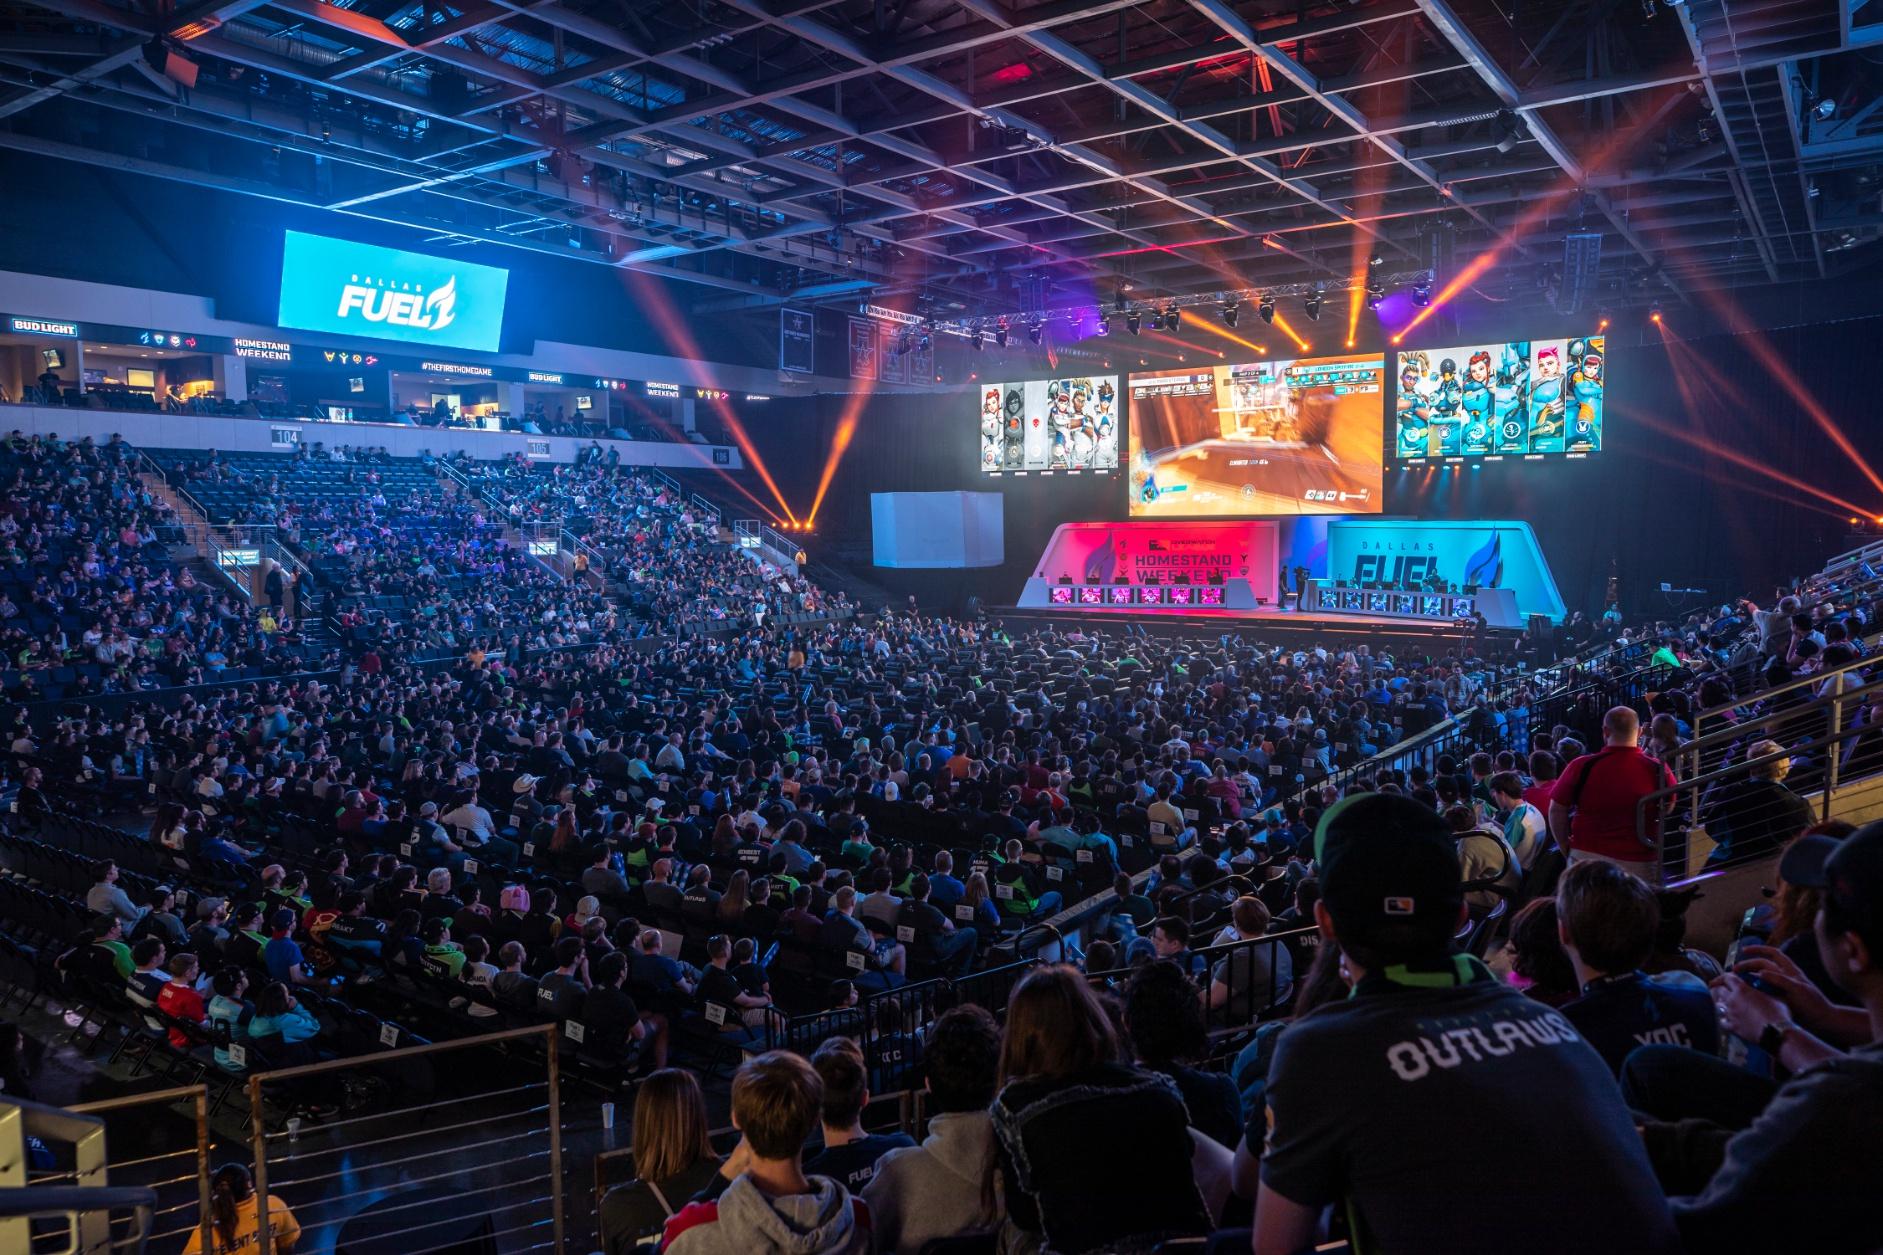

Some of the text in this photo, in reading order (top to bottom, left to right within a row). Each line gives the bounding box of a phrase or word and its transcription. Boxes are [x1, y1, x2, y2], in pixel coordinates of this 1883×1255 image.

[351, 274, 422, 292] DALLAS
[337, 285, 432, 328] FUEL
[14, 320, 75, 335] BUD LIGHT
[235, 338, 290, 351] HOMESTAND
[236, 348, 291, 361] WEEKEND
[422, 362, 492, 377] #THEFIRSTHOMEGAME
[530, 373, 561, 383] BUD LIGHT
[647, 381, 679, 391] HOMESTAND
[277, 430, 298, 443] 104
[531, 443, 546, 454] 105
[1362, 541, 1434, 551] DALLAS
[1136, 555, 1232, 566] HOMESTAND
[1386, 1012, 1579, 1081] OUTLAWS
